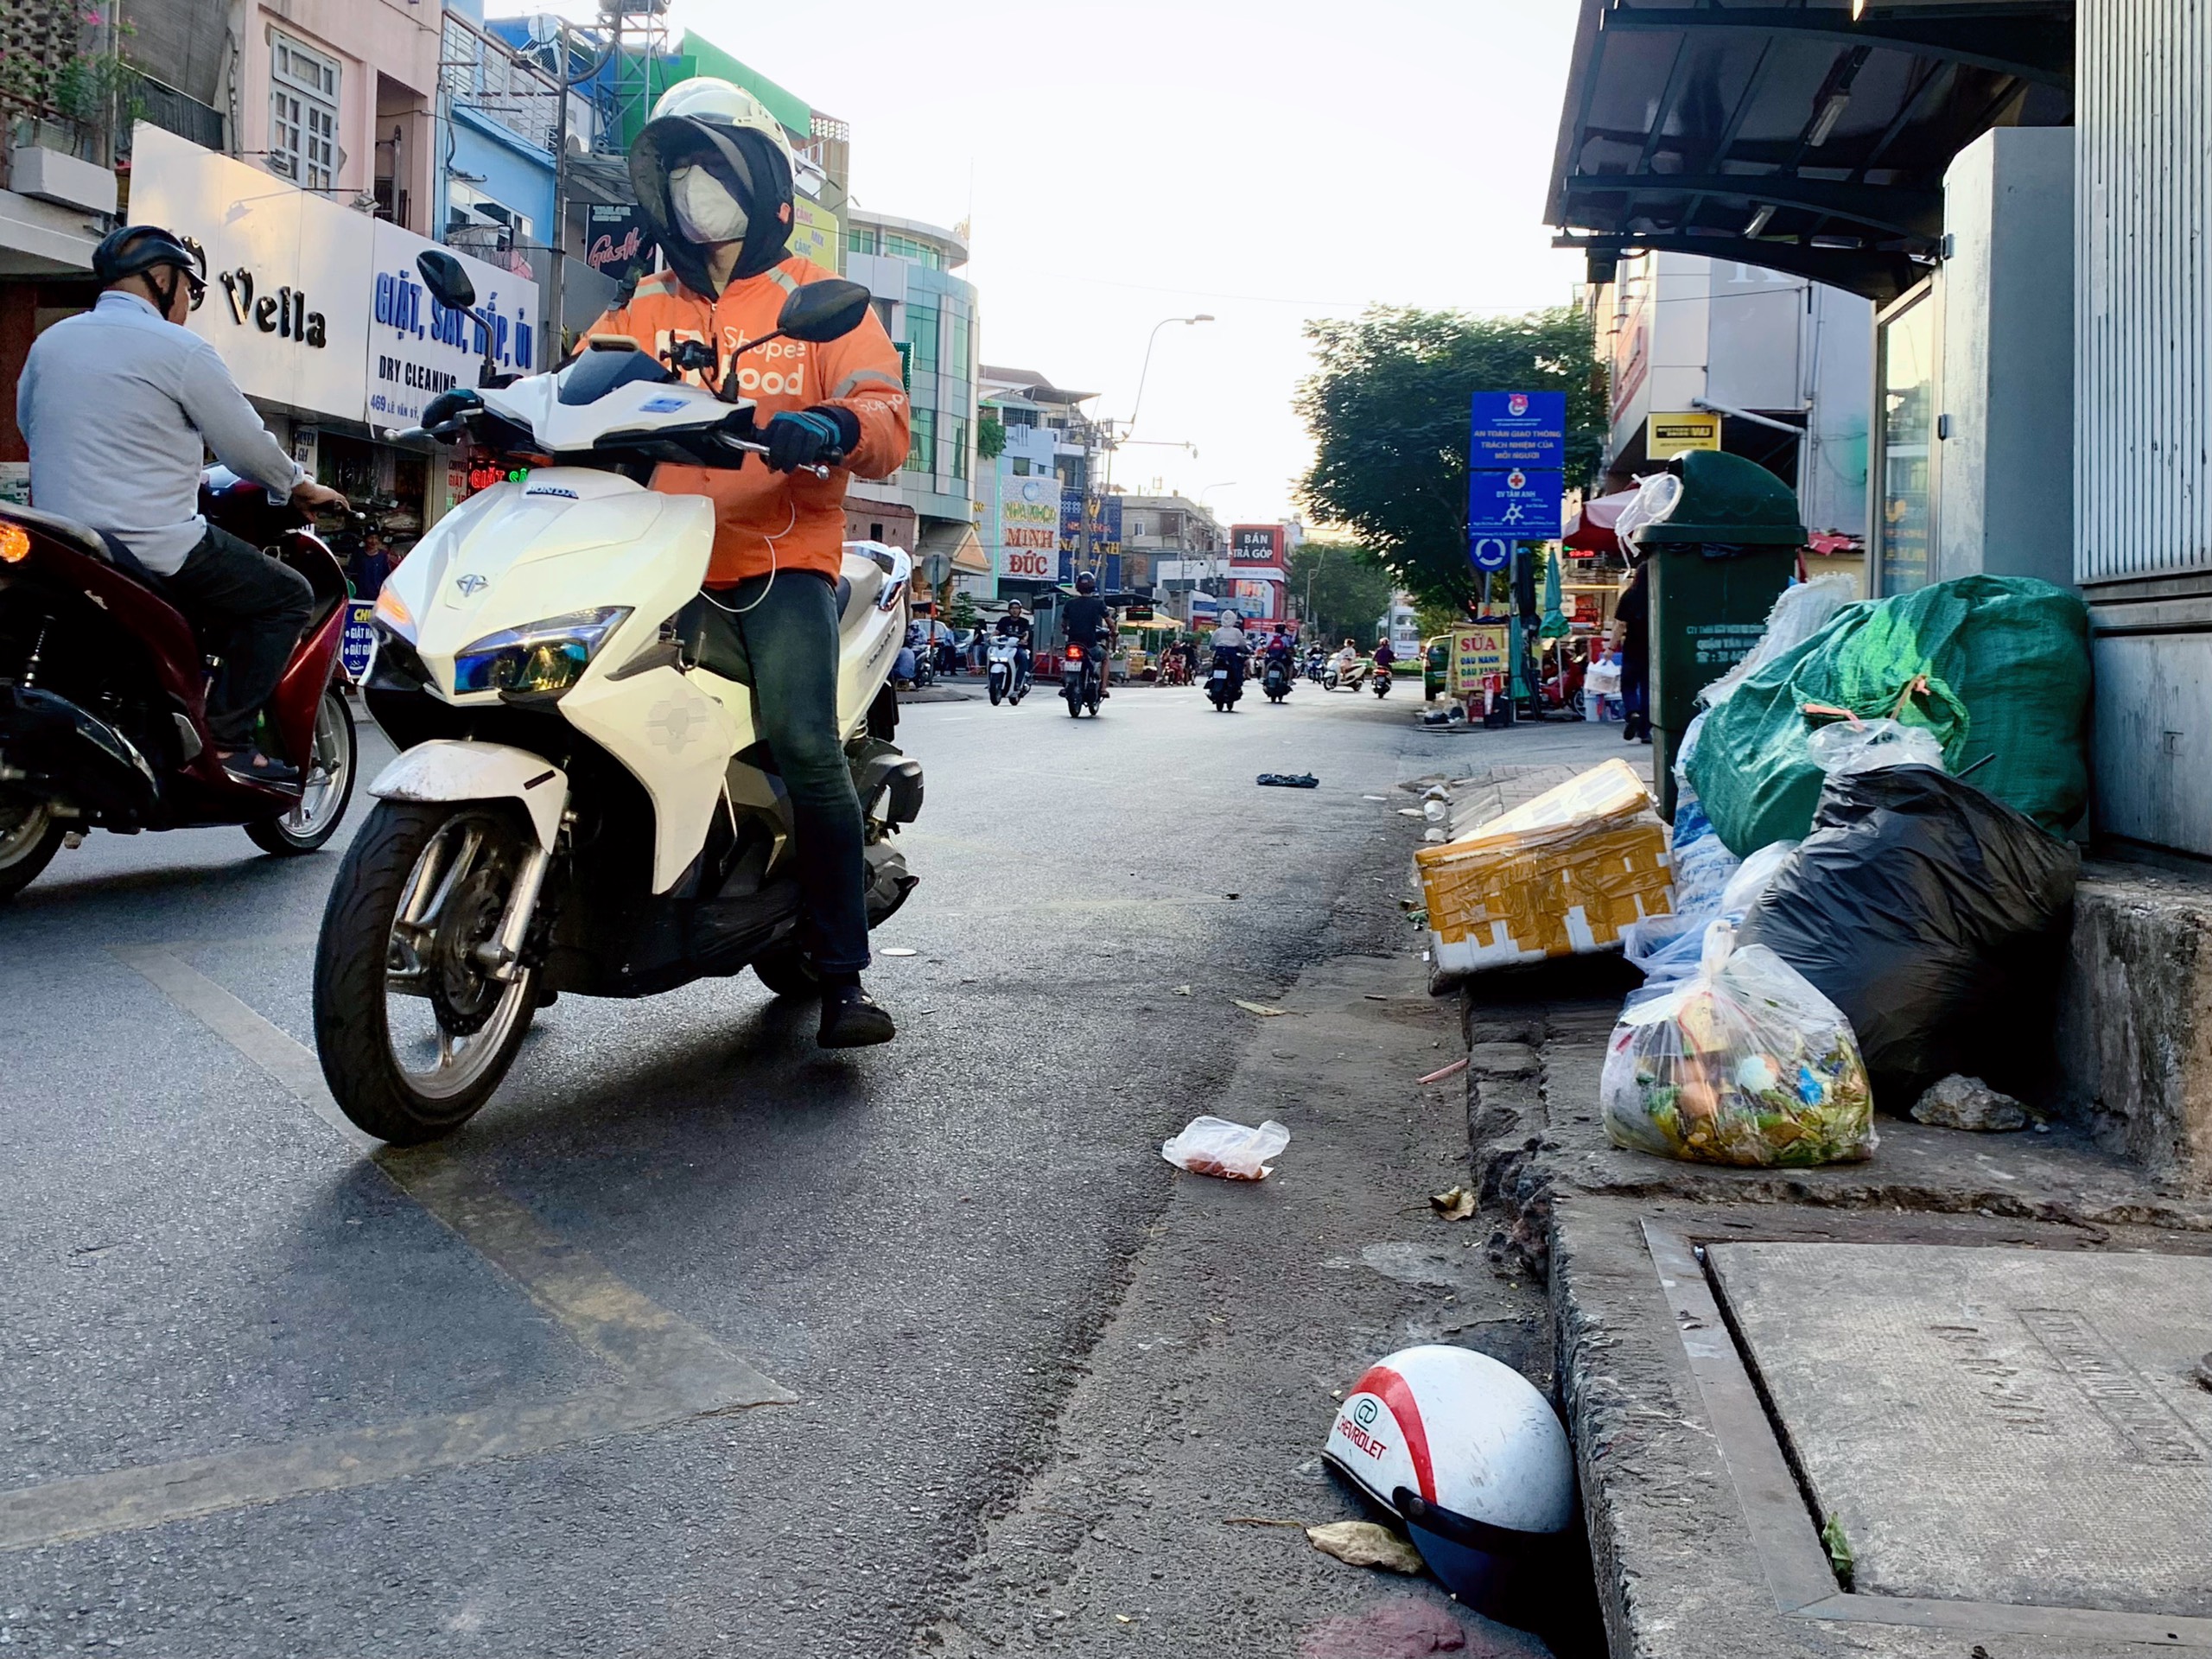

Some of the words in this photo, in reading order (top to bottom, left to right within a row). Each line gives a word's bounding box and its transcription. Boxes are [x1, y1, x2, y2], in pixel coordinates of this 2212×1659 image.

[219, 266, 327, 348] Vella
[378, 355, 401, 383] DRY
[370, 394, 386, 412] 469
[527, 486, 579, 499] HONDA
[1005, 528, 1054, 548] MINH
[1244, 532, 1268, 544] BÁN
[1009, 550, 1048, 575] ĐỨC
[1233, 546, 1249, 558] TRẢ
[1252, 546, 1273, 559] GÓP
[1337, 1414, 1387, 1460] CHEVROLET
